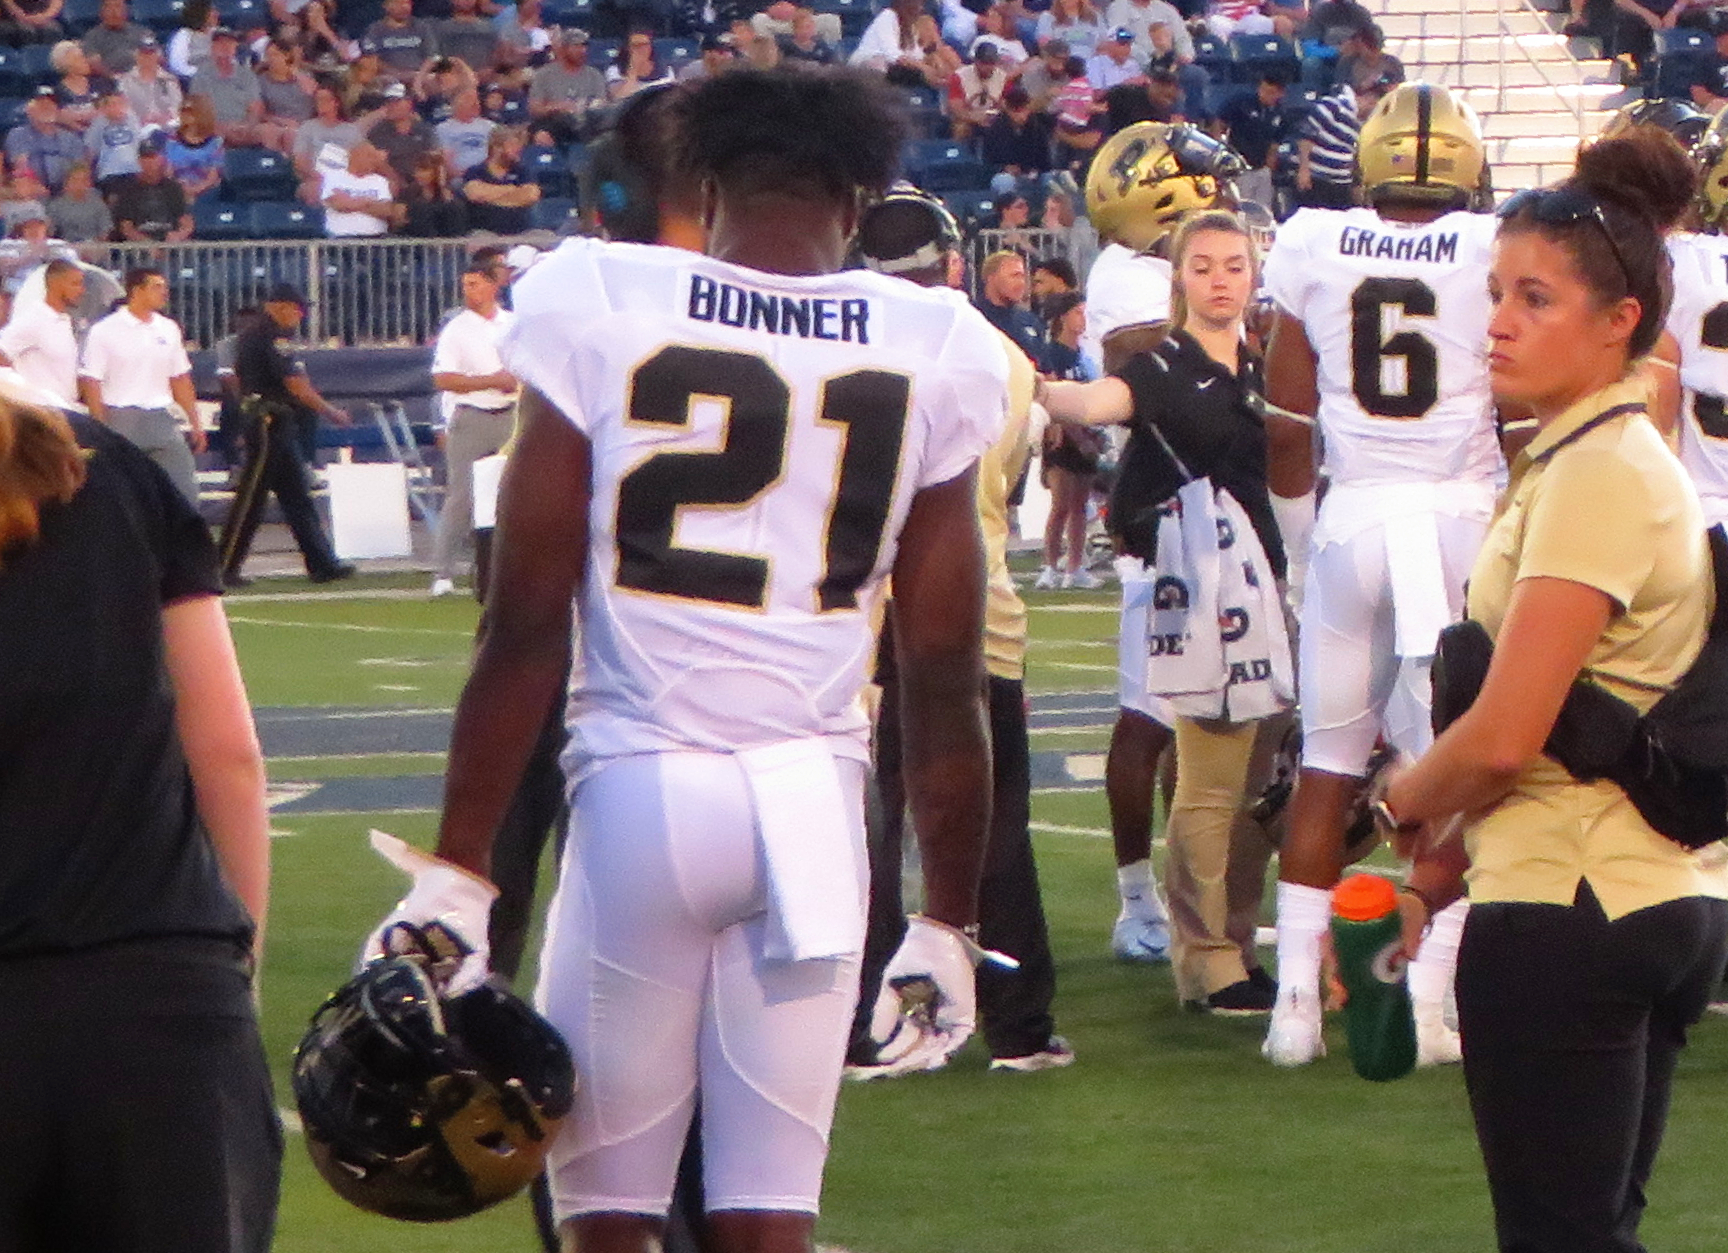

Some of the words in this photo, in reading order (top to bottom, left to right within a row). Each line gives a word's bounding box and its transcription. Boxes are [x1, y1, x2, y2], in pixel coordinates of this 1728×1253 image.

[1338, 225, 1460, 264] GRAHAM
[687, 272, 870, 345] BONNER
[1349, 275, 1440, 420] 6
[612, 342, 916, 617] 21
